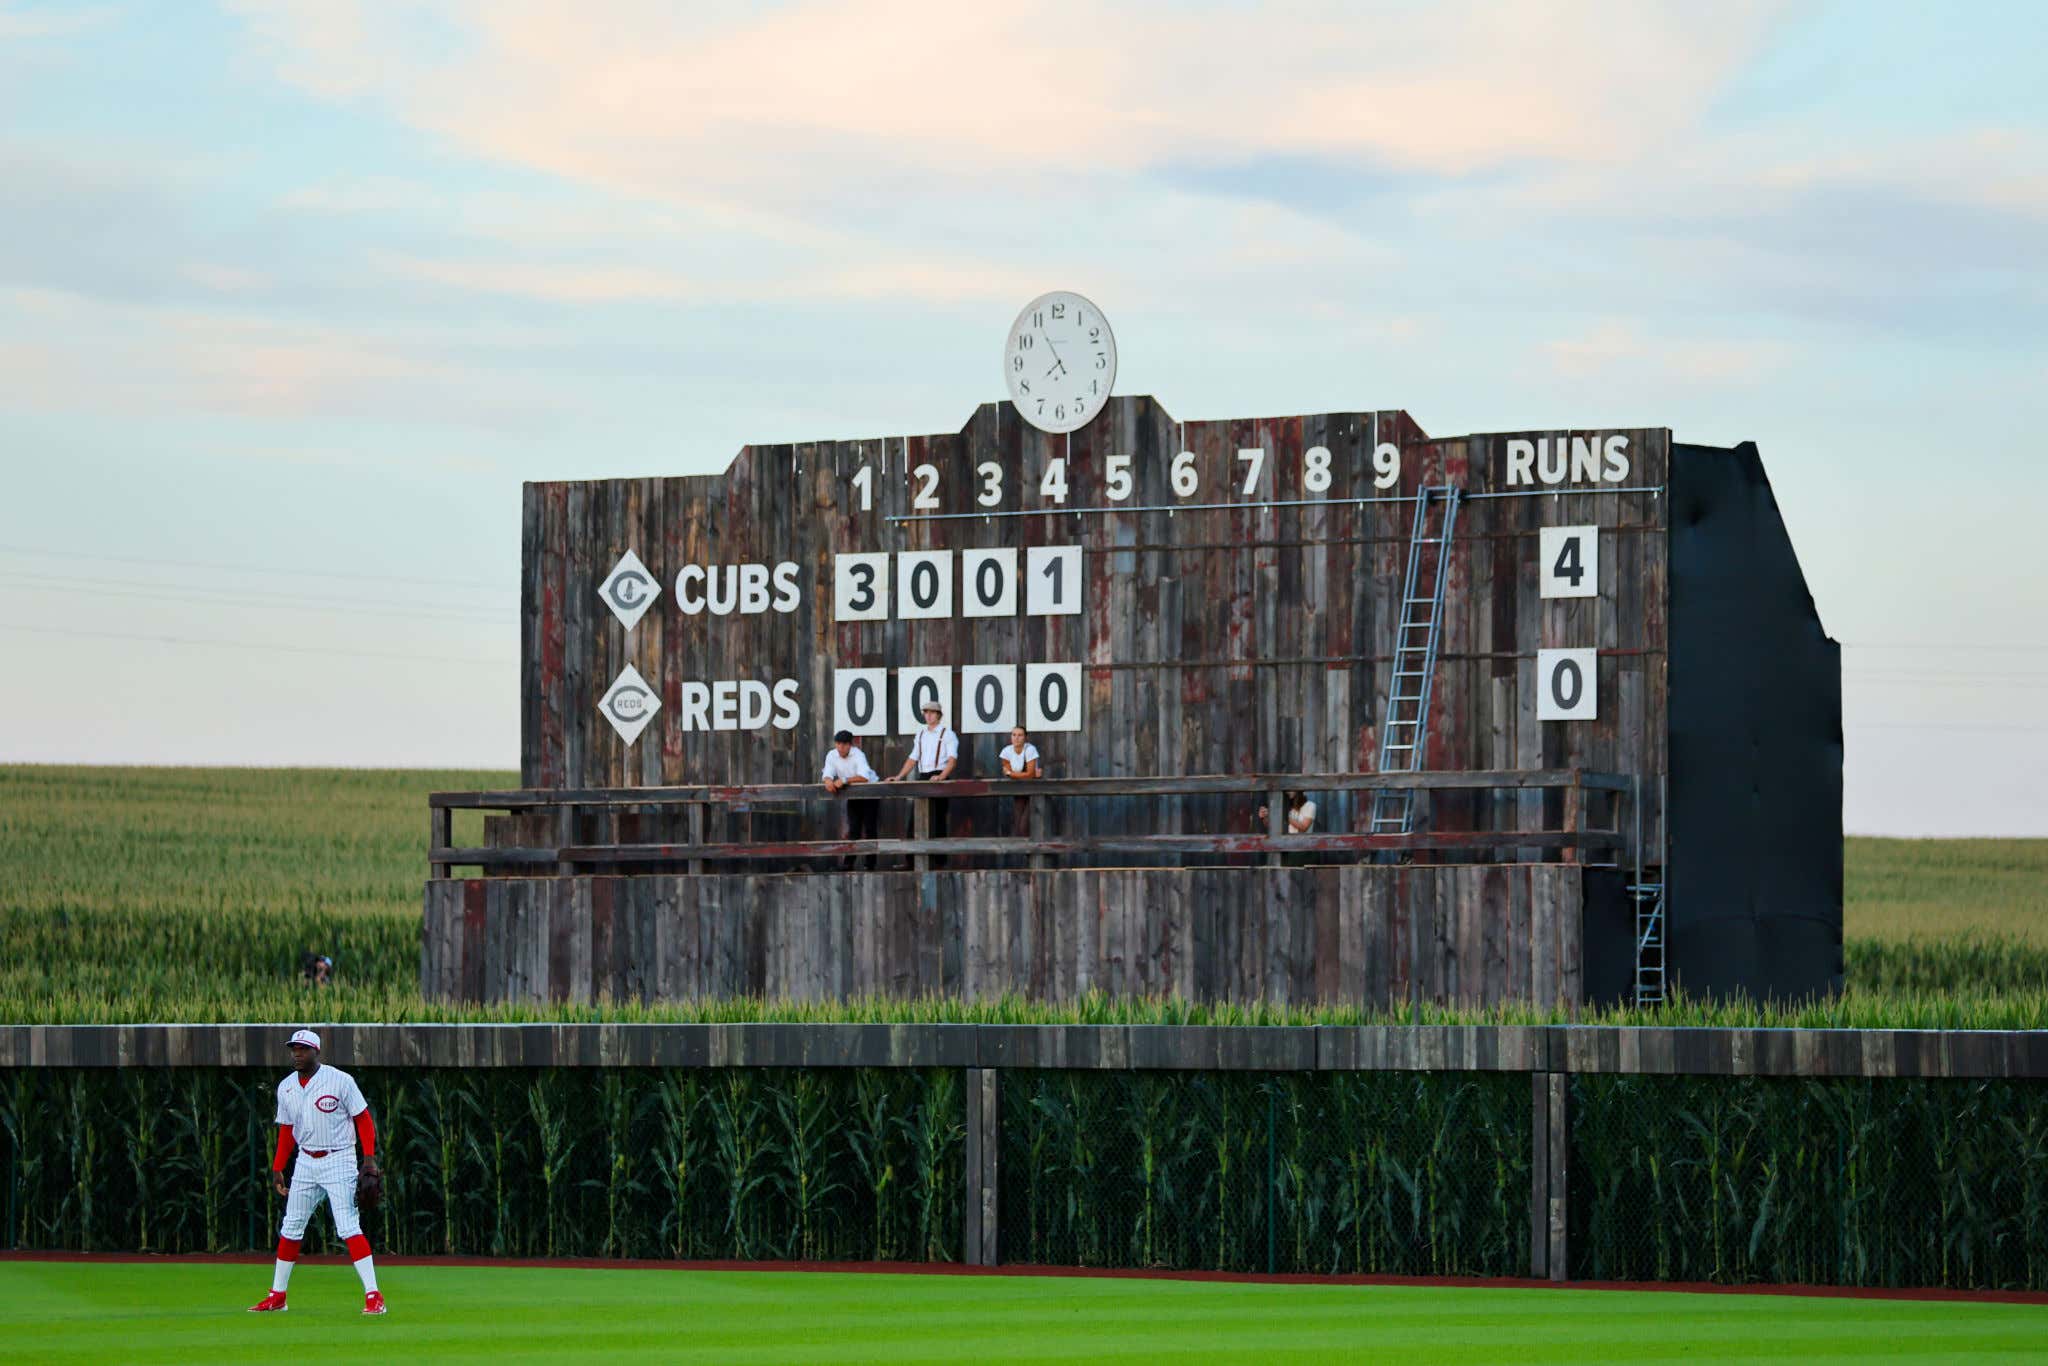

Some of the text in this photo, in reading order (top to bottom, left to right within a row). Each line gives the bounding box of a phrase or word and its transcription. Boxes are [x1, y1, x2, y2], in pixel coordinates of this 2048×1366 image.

[1034, 312, 1043, 328] 11
[1052, 303, 1065, 320] 12
[1019, 334, 1033, 350] 10
[1089, 327, 1099, 344] 2
[1014, 355, 1023, 372] 9
[1020, 379, 1030, 395] 8
[1037, 399, 1046, 415] 7
[1055, 404, 1065, 420] 6
[1074, 397, 1084, 414] 5
[853, 436, 1630, 511] 1 2 3 4 5 6 7 8 9 RUNS
[675, 536, 1585, 615] CUBS 3 0 0 1 4
[682, 658, 1583, 731] REDS 0 0 0 0 0
[617, 699, 642, 709] REDS
